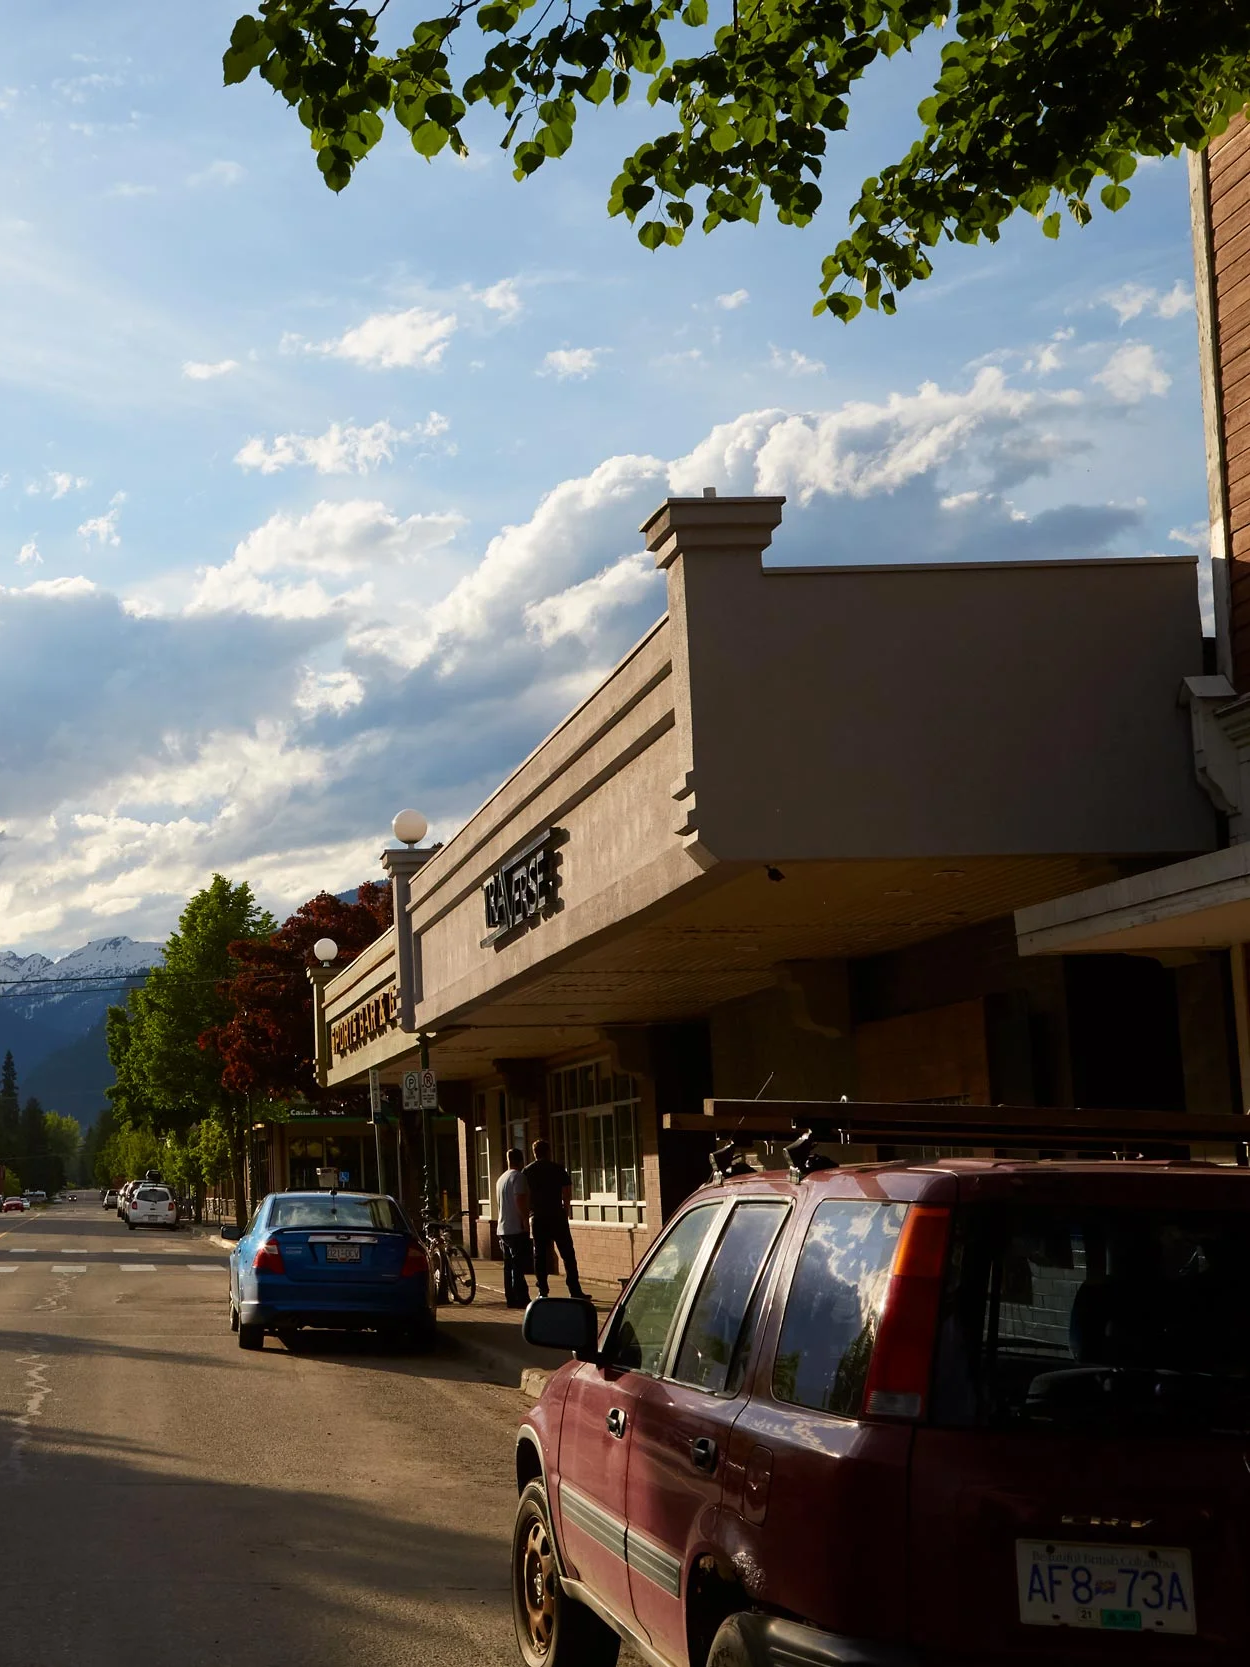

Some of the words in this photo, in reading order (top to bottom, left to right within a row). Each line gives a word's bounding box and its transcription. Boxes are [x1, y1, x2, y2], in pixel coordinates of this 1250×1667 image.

[480, 830, 550, 947] TRAVERSE
[331, 1013, 357, 1054] SPORTS
[359, 1001, 377, 1038] BAR
[379, 993, 386, 1026] &
[1032, 1550, 1081, 1563] Beautiful
[1083, 1554, 1118, 1565] British
[1120, 1555, 1176, 1569] Columbia
[1028, 1563, 1093, 1604] AF8
[1118, 1568, 1188, 1612] 73A
[1080, 1610, 1092, 1620] 21
